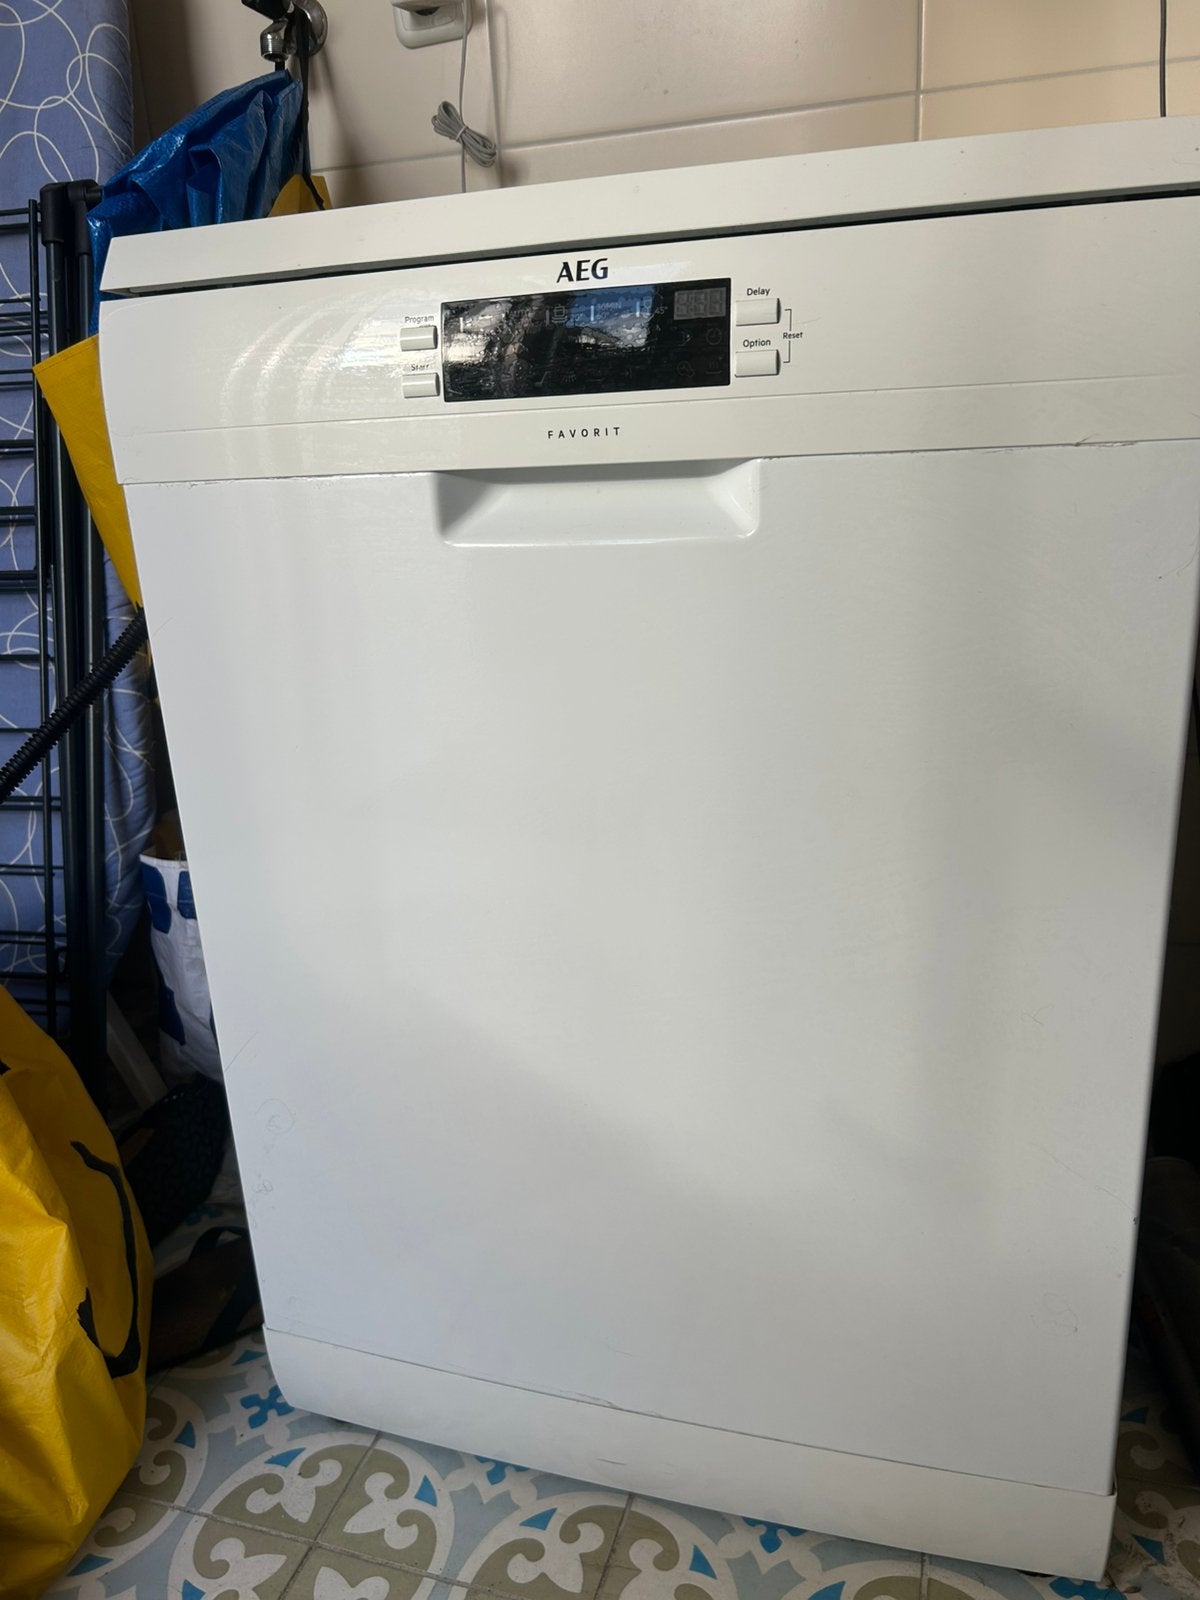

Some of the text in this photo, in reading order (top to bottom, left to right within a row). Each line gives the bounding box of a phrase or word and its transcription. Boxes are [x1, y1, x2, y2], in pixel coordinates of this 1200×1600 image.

[556, 257, 609, 283] AEG
[746, 287, 771, 297] Delay
[404, 315, 435, 325] Program
[782, 331, 803, 340] Reset
[742, 338, 771, 349] Option
[547, 426, 620, 439] FAVORIT
